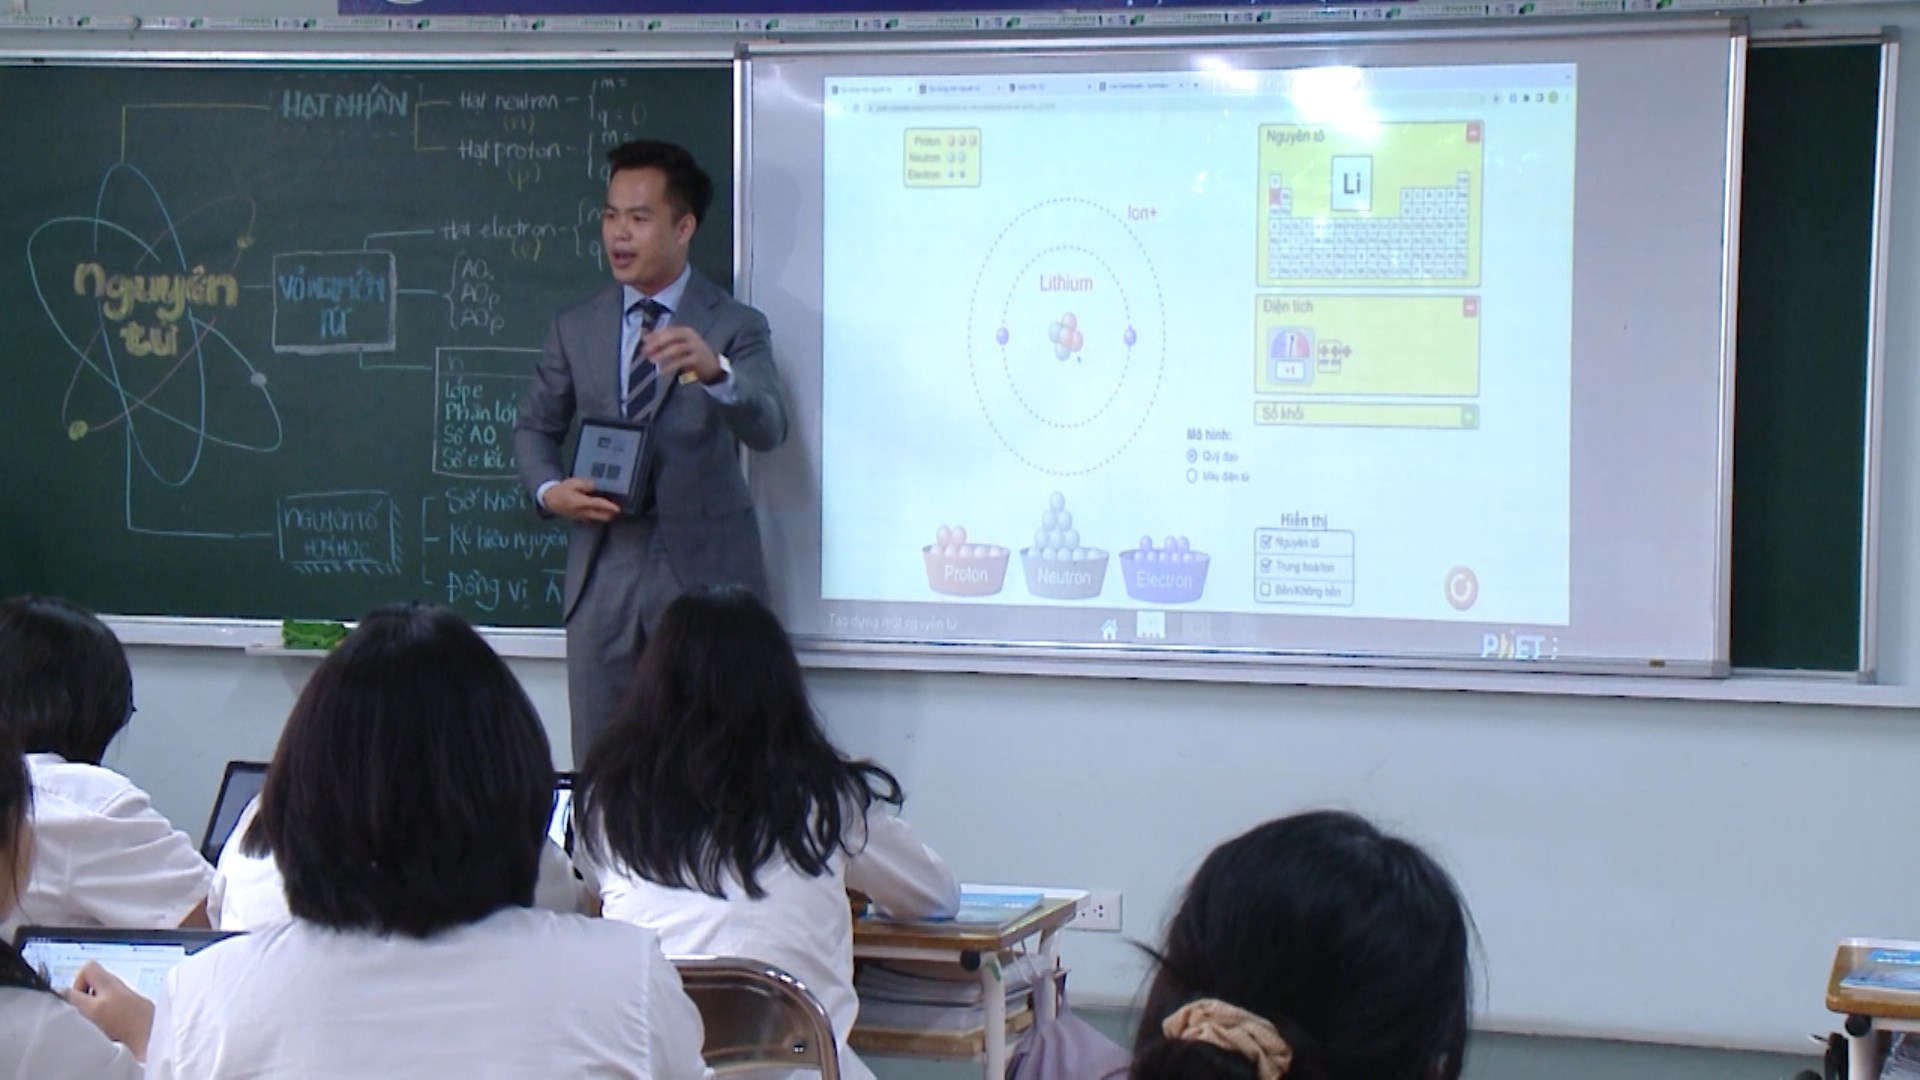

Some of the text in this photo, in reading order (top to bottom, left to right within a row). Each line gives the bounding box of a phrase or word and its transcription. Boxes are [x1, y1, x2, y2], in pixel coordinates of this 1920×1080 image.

[1343, 172, 1361, 194] Li
[1039, 273, 1094, 293] Lithium
[944, 564, 989, 584] Proton
[1036, 566, 1092, 586] Neutron
[1136, 568, 1193, 590] Electron
